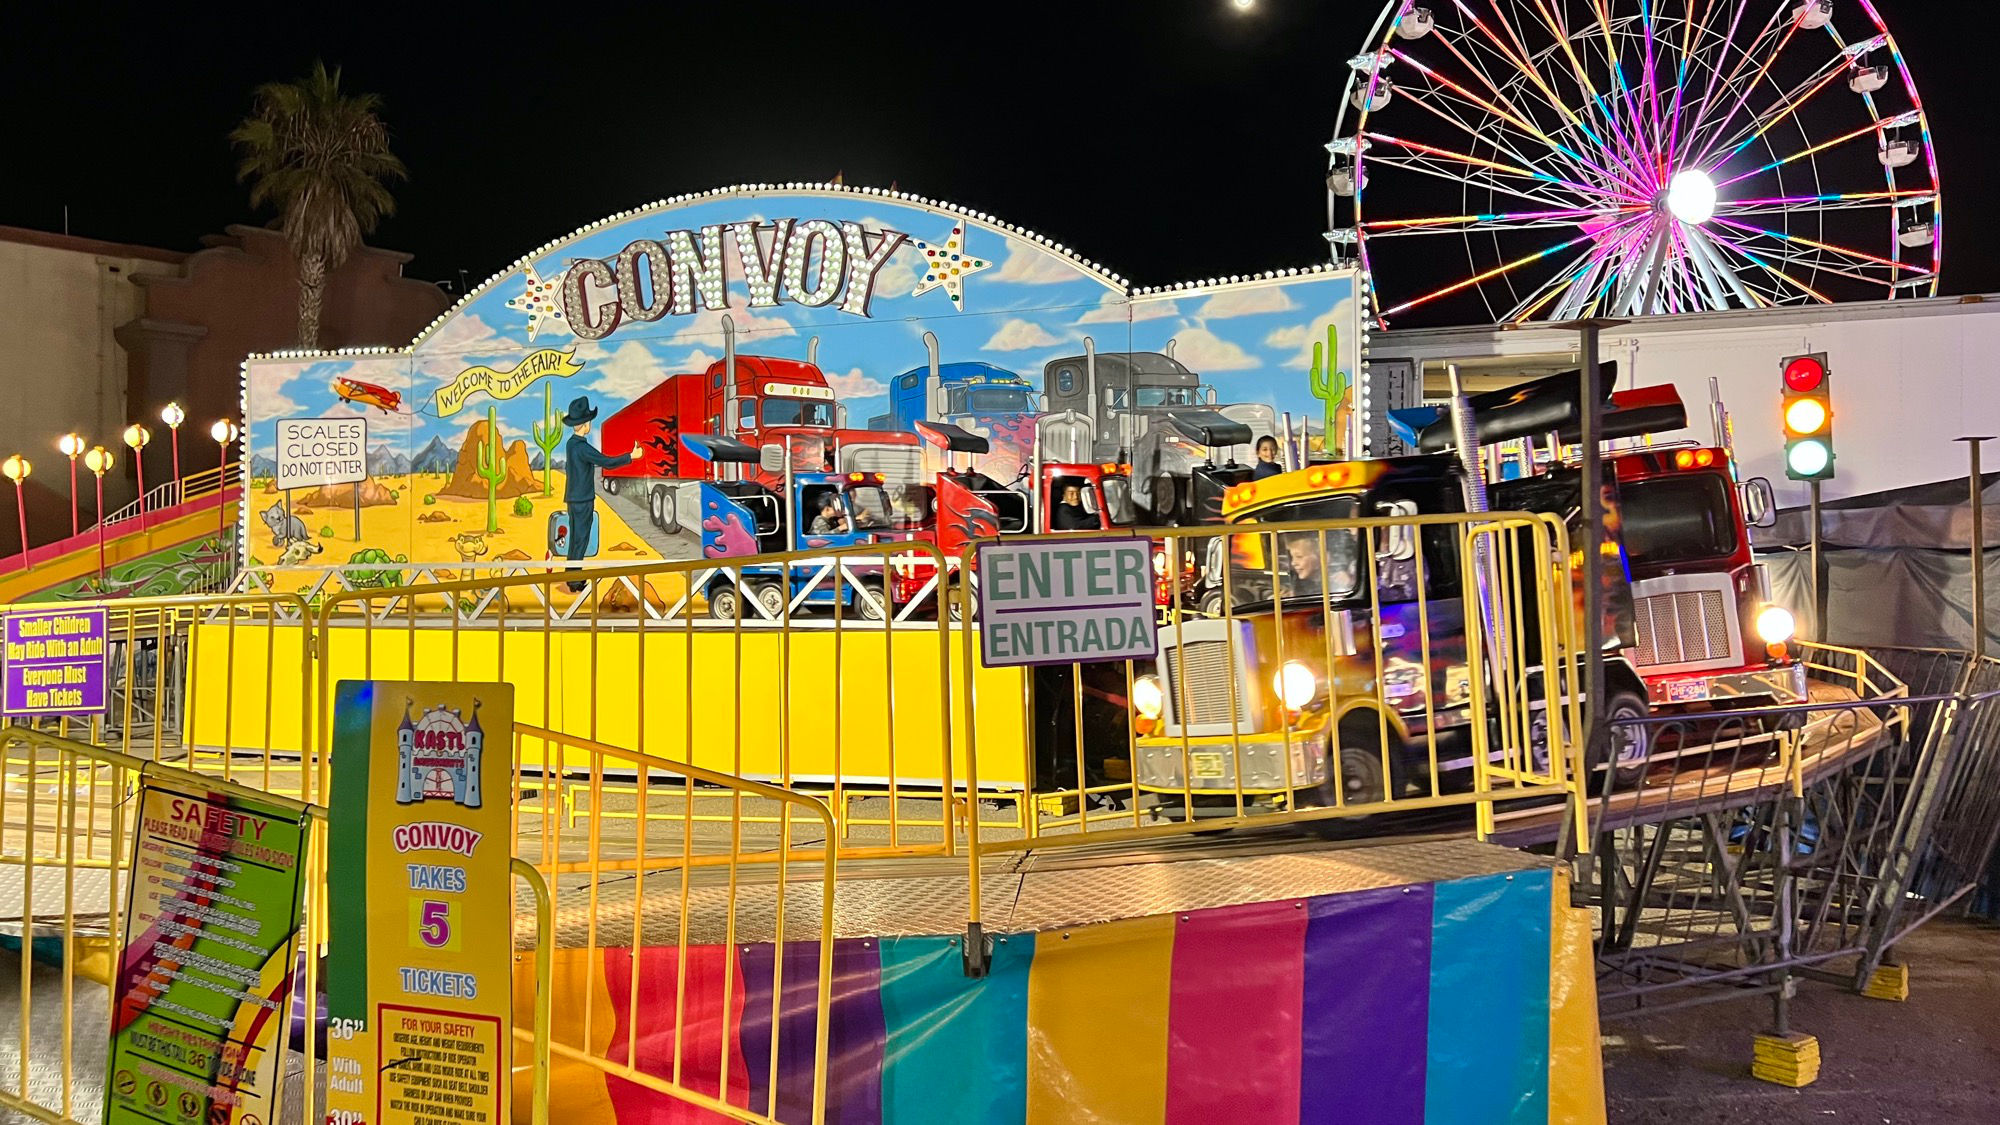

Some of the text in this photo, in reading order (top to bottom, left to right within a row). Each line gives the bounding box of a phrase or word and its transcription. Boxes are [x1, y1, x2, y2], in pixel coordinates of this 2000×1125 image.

[563, 218, 909, 340] CONVOY
[441, 353, 561, 409] WELCOME TO THE FAIR!
[288, 425, 360, 440] SCALES
[287, 442, 358, 458] CLOSED
[282, 460, 362, 478] DO NOT ENTER
[988, 548, 1147, 600] ENTER
[19, 616, 91, 637] Smaller Children
[990, 616, 1151, 657] ENTRADA
[8, 637, 102, 661] May Ride With an Adult
[23, 666, 87, 686] Everyone Must
[26, 688, 82, 707] Have Tickets
[413, 730, 465, 751] KASTL
[143, 817, 169, 836] PLEASE
[169, 823, 188, 840] READ
[189, 827, 202, 843] ALL
[170, 799, 268, 841] SAFETY
[394, 822, 482, 856] CONVOY
[407, 864, 466, 893] TAKES
[420, 900, 451, 947] 5
[399, 967, 477, 999] TICKETS
[402, 1018, 475, 1038] FOR YOUR SAFETY
[333, 1056, 361, 1075] With
[330, 1075, 363, 1094] Adult
